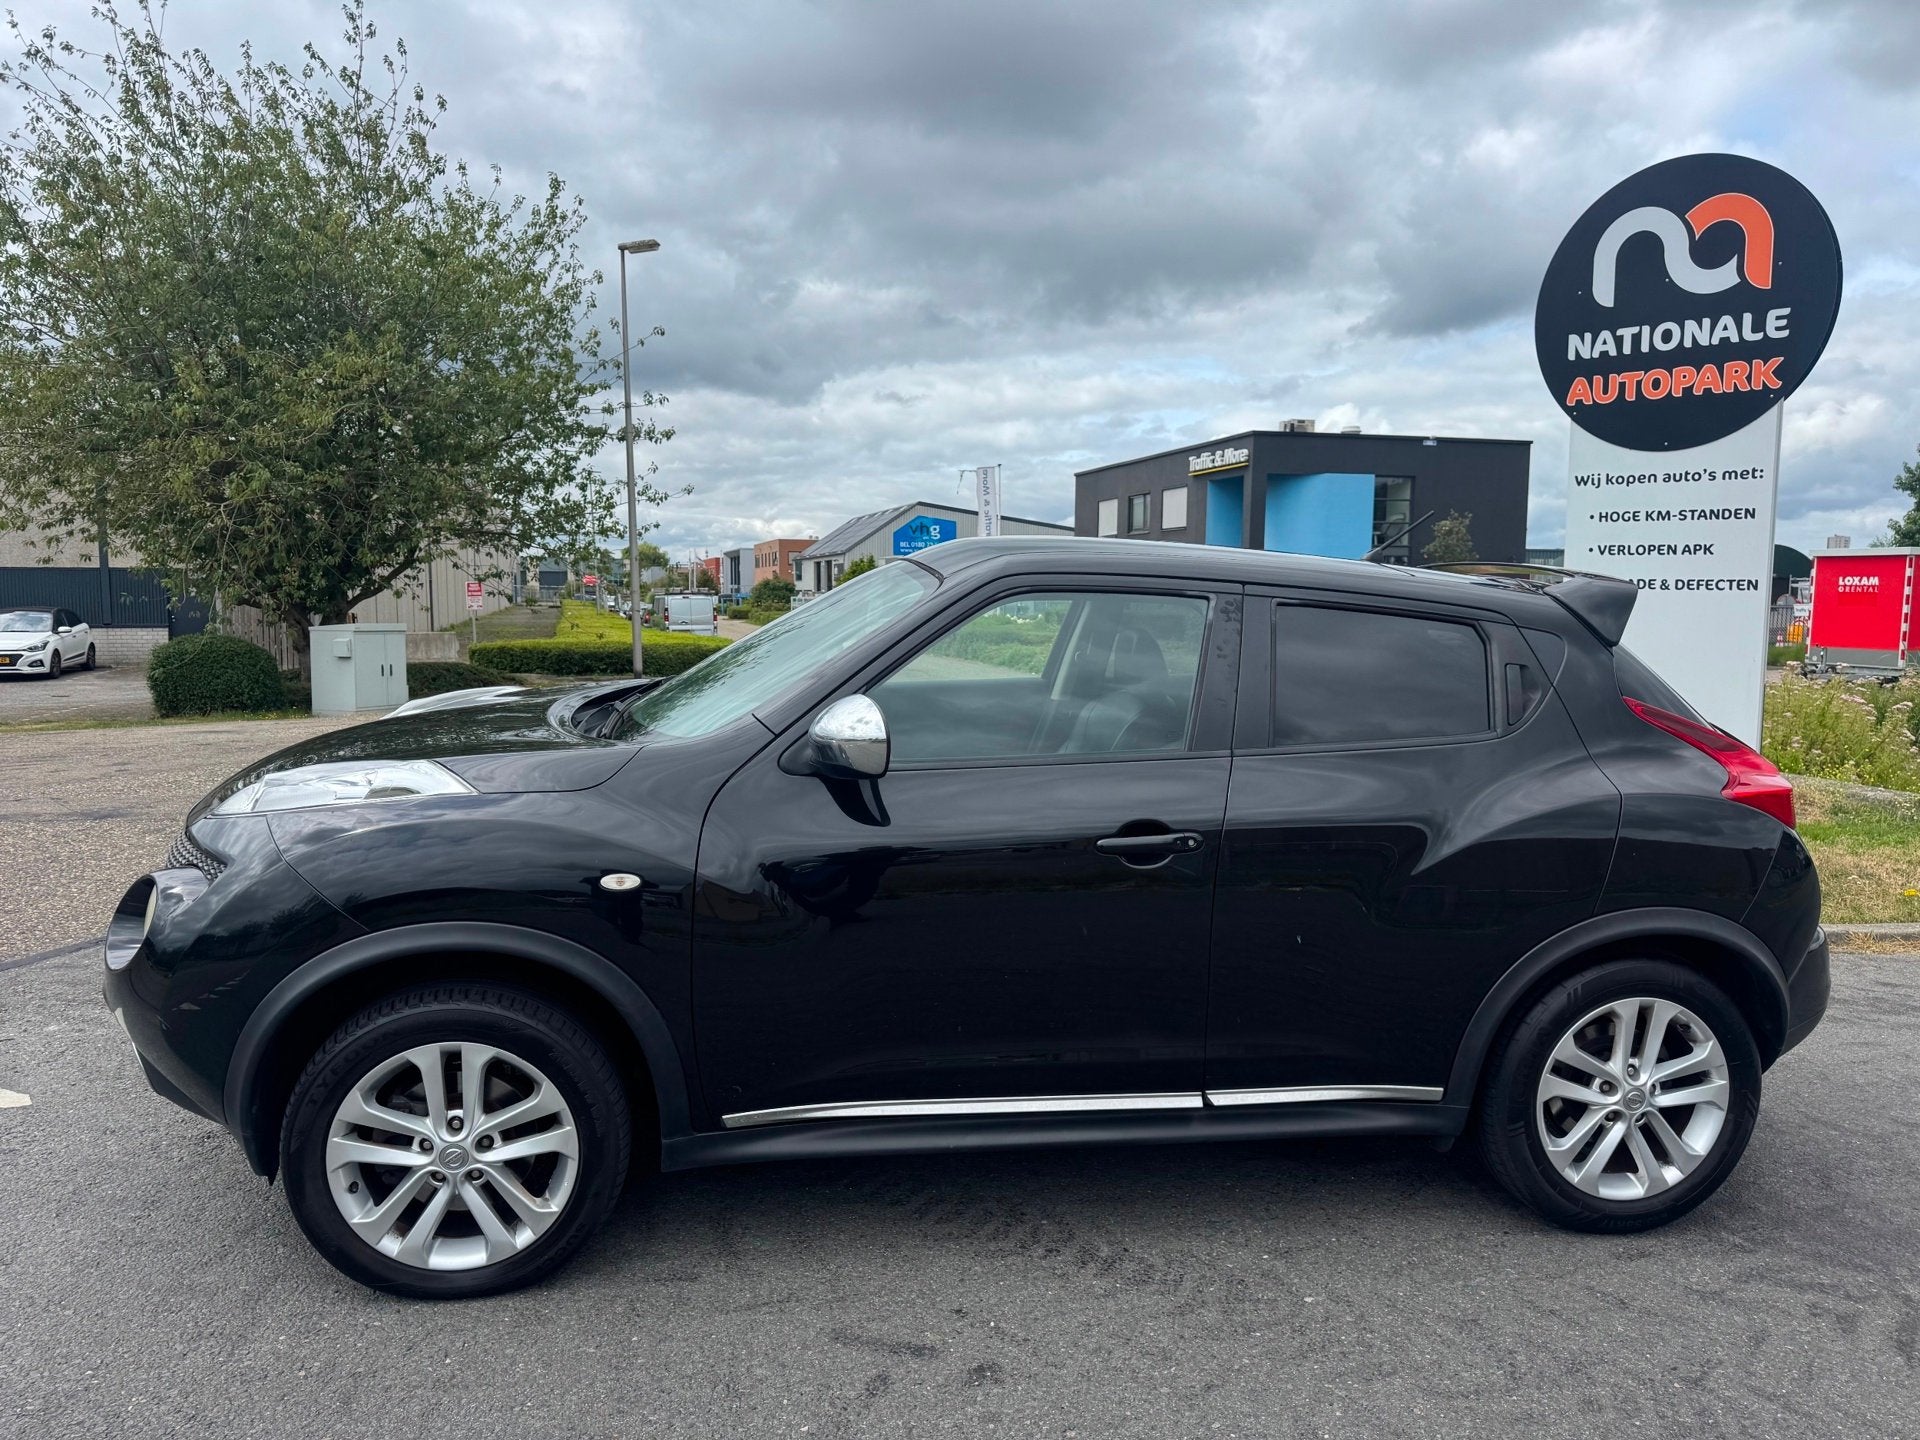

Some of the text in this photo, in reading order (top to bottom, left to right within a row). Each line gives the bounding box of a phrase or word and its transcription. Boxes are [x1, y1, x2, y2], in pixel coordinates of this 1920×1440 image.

[1567, 307, 1792, 361] NATIONALE
[1566, 356, 1785, 406] AUTOPARK
[1224, 447, 1249, 464] More
[1574, 464, 1766, 489] Wij kopen auto's met:
[1598, 507, 1757, 524] HOGE KM-STANDEN
[909, 521, 941, 540] vhg
[1597, 541, 1716, 558] VERLOPEN APK
[1659, 578, 1671, 591] &
[1674, 578, 1760, 592] DEFECTEN
[1838, 575, 1879, 586] LOXAM
